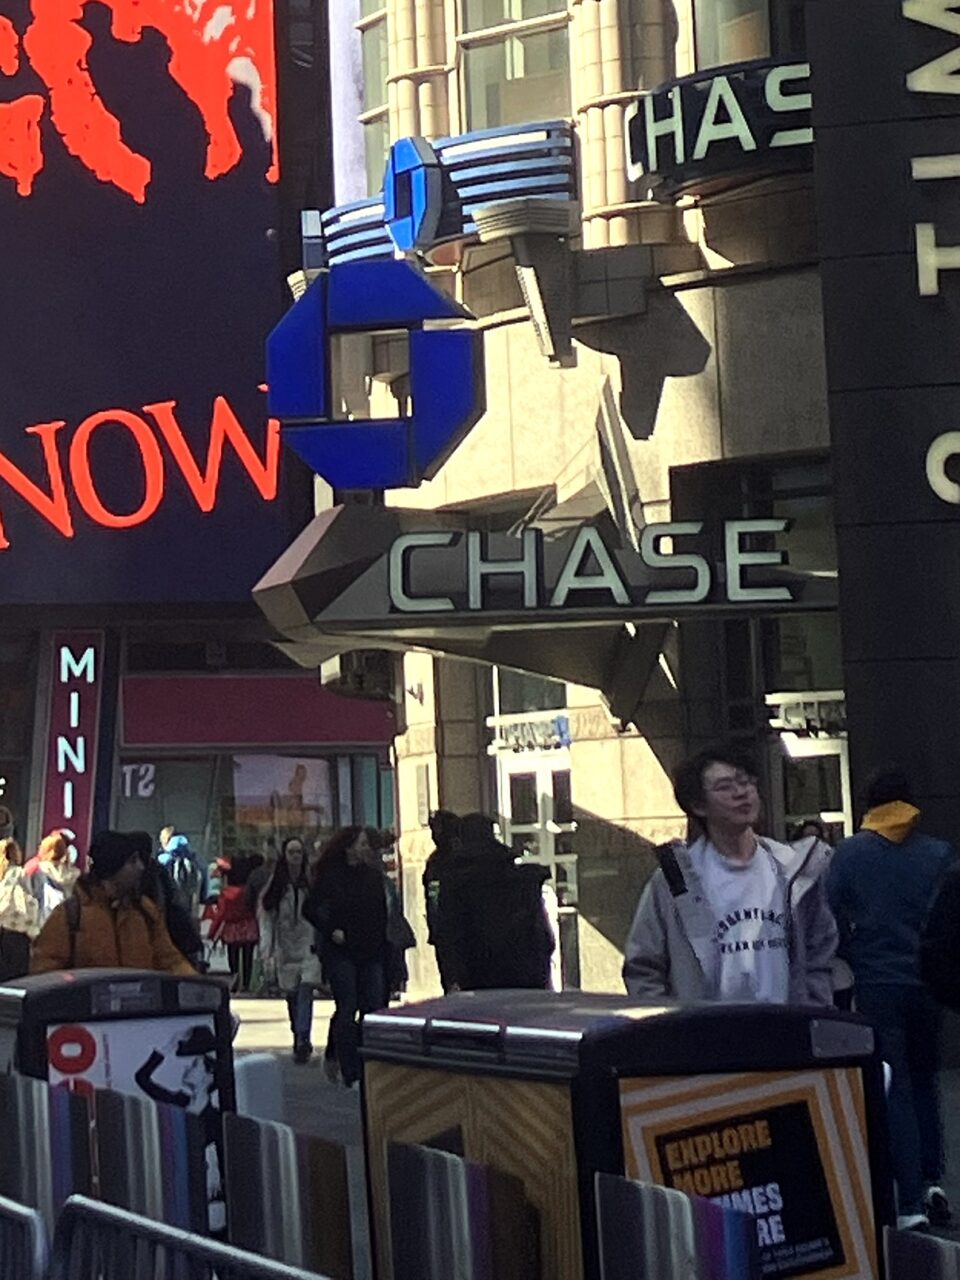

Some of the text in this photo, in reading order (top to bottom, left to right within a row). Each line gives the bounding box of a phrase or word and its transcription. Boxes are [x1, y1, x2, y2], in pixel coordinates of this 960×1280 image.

[624, 62, 814, 183] CHAS
[388, 519, 795, 612] CHASE
[665, 1119, 772, 1171] EXPLORE
[672, 1159, 744, 1196] MORE
